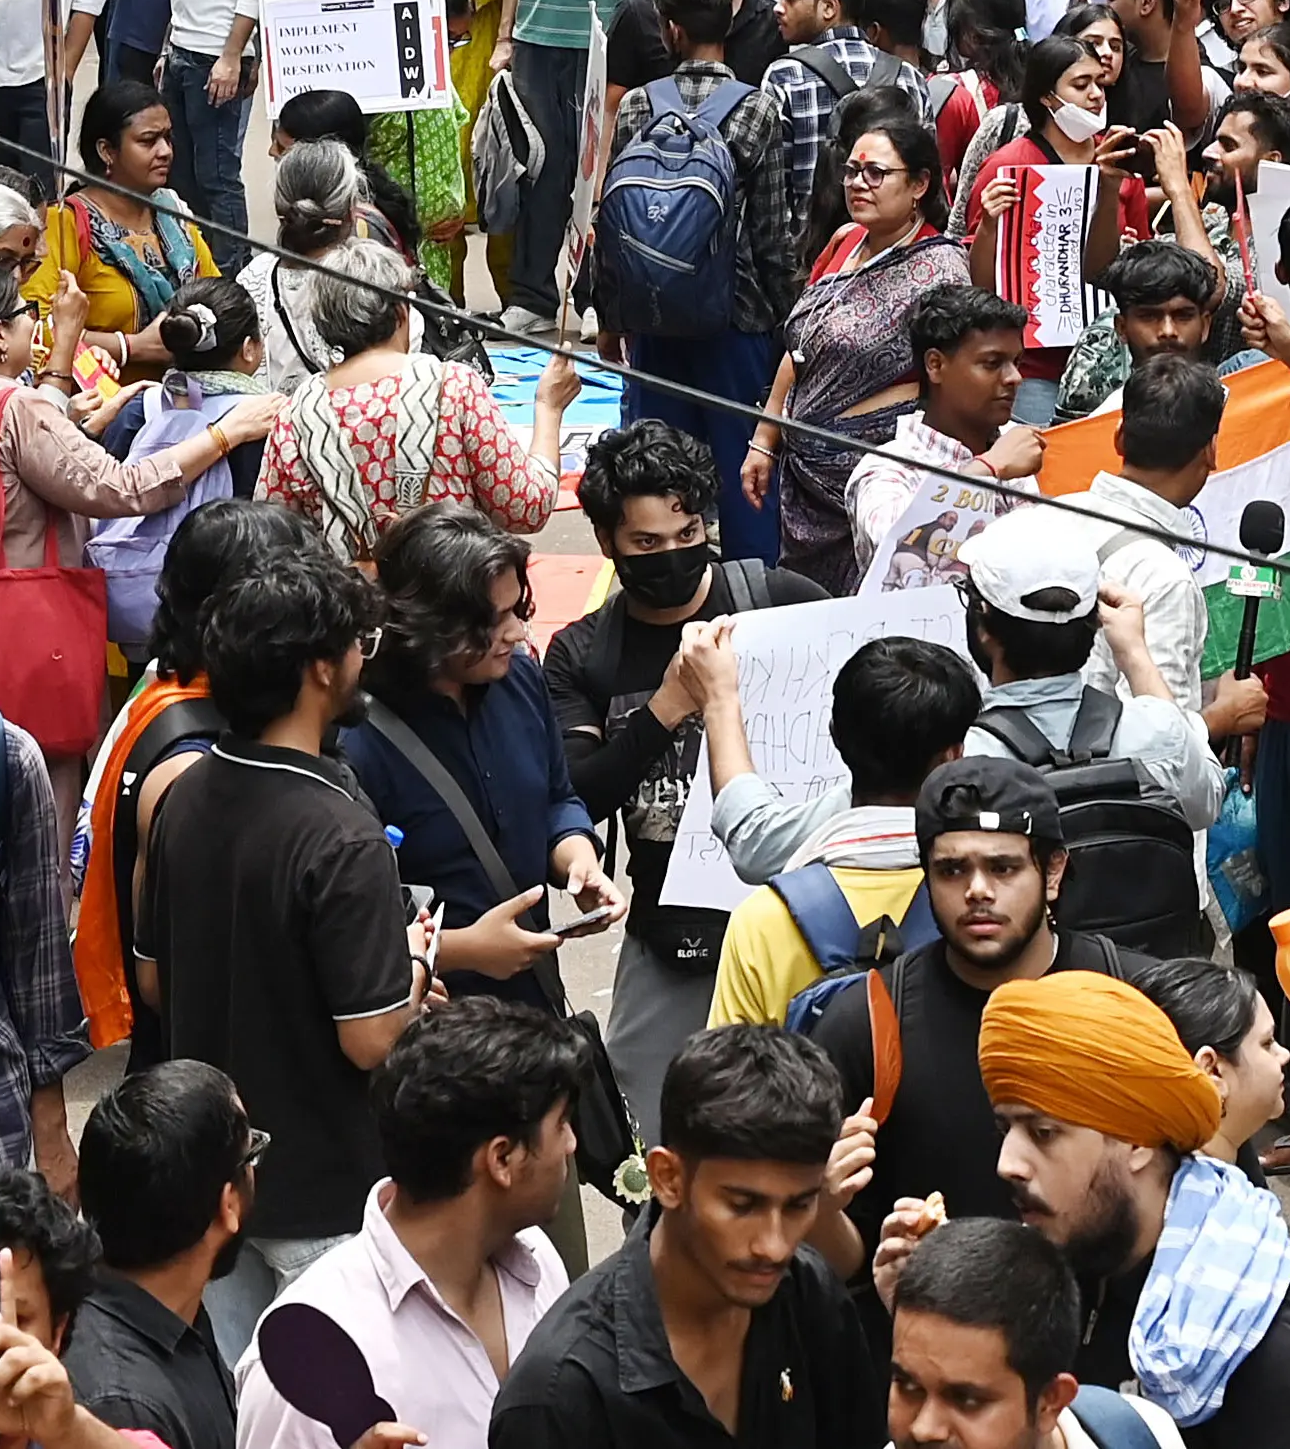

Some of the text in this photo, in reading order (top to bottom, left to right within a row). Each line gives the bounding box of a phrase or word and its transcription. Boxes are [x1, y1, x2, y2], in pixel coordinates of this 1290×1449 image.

[279, 22, 358, 38] IMPLEMENT
[281, 43, 345, 56] WOMEN'S
[283, 60, 376, 76] RESERVATION
[285, 84, 314, 95] NOW
[1072, 220, 1080, 234] on
[1042, 223, 1057, 307] characters
[1058, 206, 1072, 313] DHURANDHAR 3
[1070, 239, 1080, 275] based
[1072, 307, 1082, 329] can
[931, 484, 950, 502] 2
